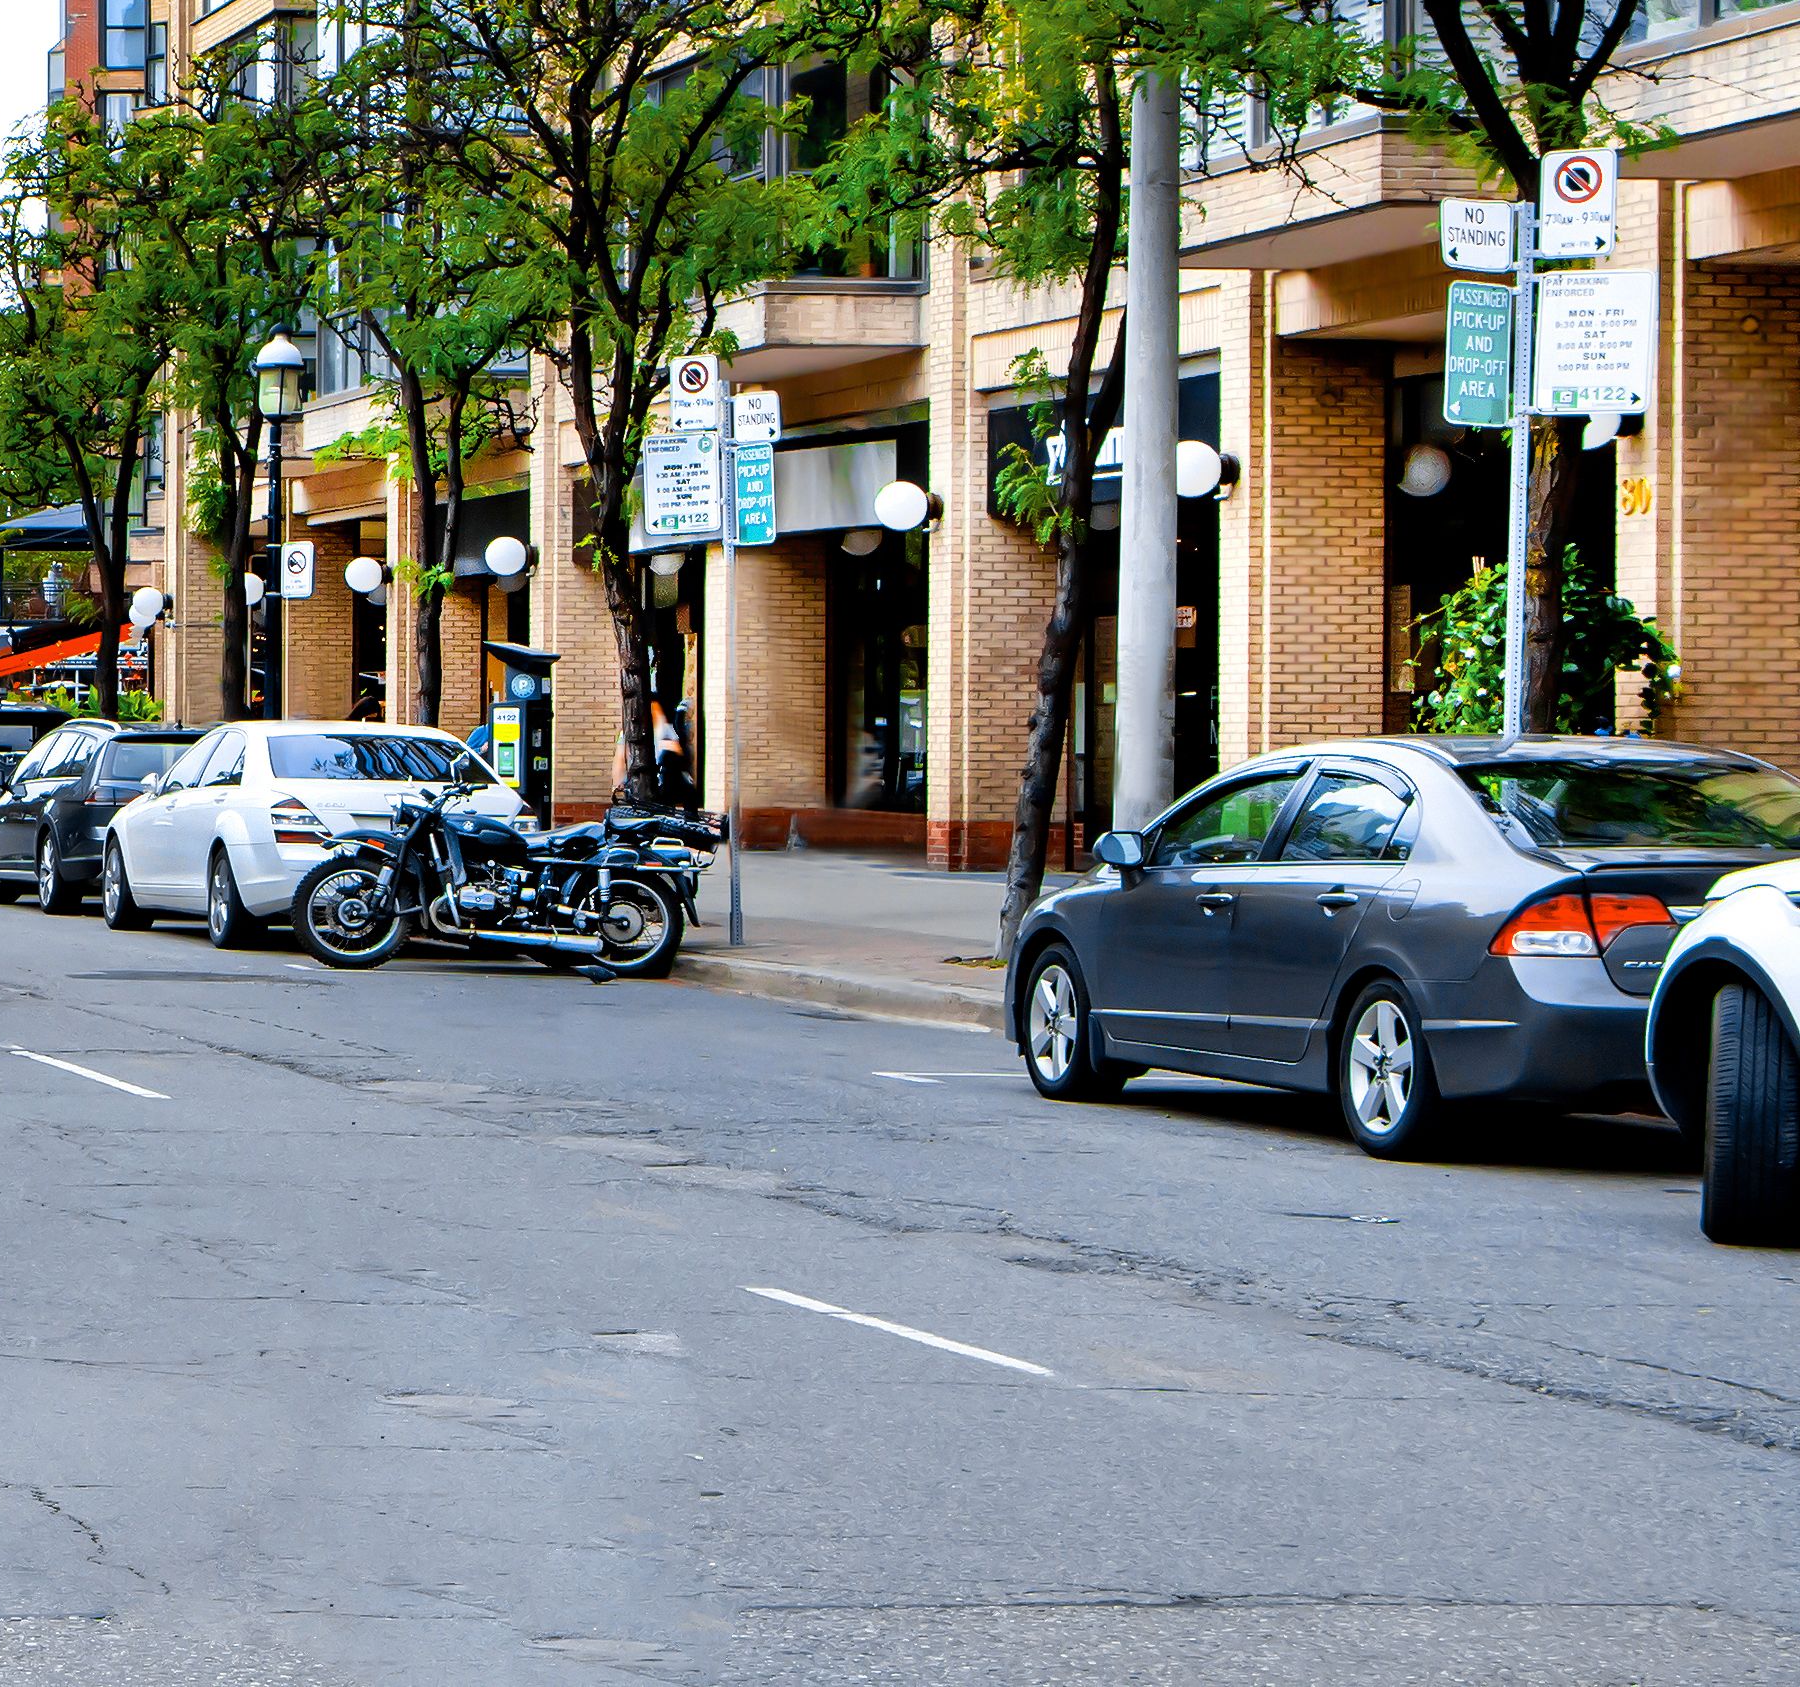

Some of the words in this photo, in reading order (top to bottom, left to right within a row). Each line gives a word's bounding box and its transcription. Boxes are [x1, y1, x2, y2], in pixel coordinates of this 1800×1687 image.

[1464, 207, 1485, 225] NO
[1447, 226, 1506, 247] STANDING
[1546, 278, 1563, 286] PAY
[1567, 277, 1610, 286] PARKING
[1452, 287, 1509, 308] PASSENGER
[1545, 289, 1595, 297] ENFORCED
[1568, 309, 1595, 318] MON
[1605, 309, 1625, 317] FRI
[1453, 310, 1506, 332] PICK-UP
[1578, 320, 1593, 328] AM
[1623, 319, 1637, 327] PM
[1583, 331, 1607, 339] SAT
[1465, 335, 1493, 353] AND
[1578, 342, 1592, 350] AM
[1619, 341, 1633, 349] PM
[1583, 352, 1607, 360] SUN
[1449, 356, 1507, 376] DROP-OFF
[1575, 363, 1589, 371] PM
[1616, 362, 1630, 370] PM
[1459, 380, 1496, 398] AREA
[1579, 387, 1626, 400] 4122
[748, 398, 762, 410] NO
[737, 412, 776, 427] STANDING
[738, 463, 770, 479] PICK-UP
[746, 480, 764, 493] AND
[737, 495, 773, 511] DROP-OFF
[679, 513, 709, 524] 4122
[744, 511, 768, 525] AREA
[496, 714, 517, 722] 4122
